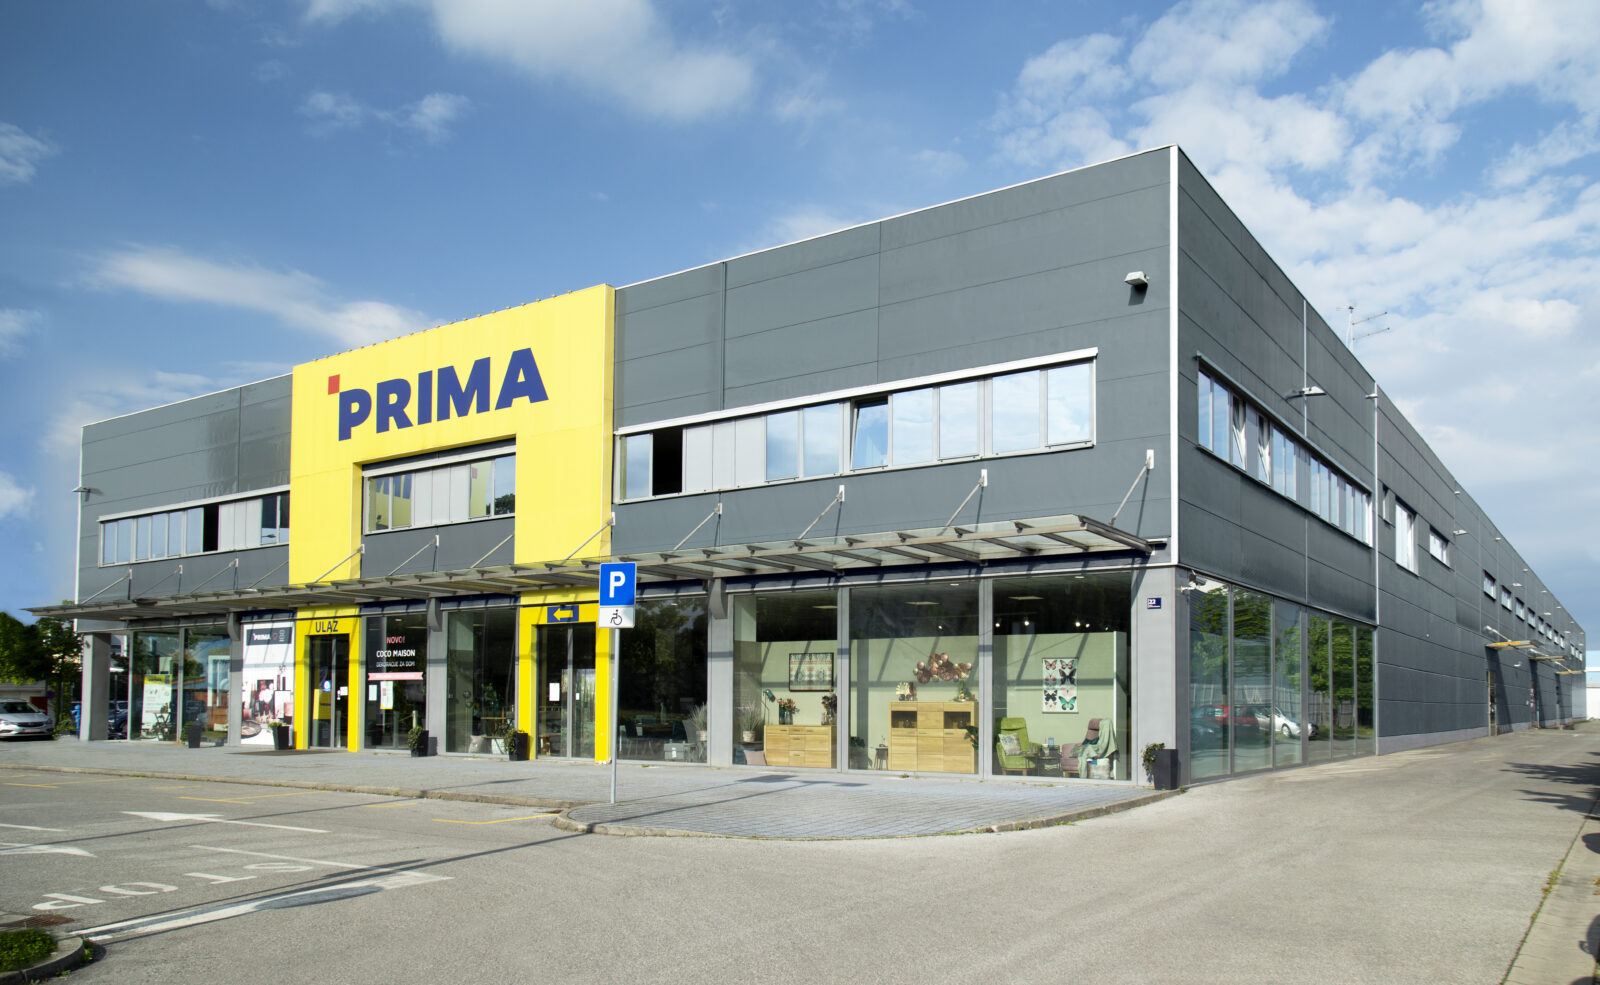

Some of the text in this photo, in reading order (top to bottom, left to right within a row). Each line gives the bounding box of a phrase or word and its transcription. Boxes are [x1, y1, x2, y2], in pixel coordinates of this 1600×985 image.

[337, 347, 549, 441] PRIMA
[609, 571, 626, 598] P
[315, 620, 339, 632] ULAZ
[393, 649, 416, 657] MAISON
